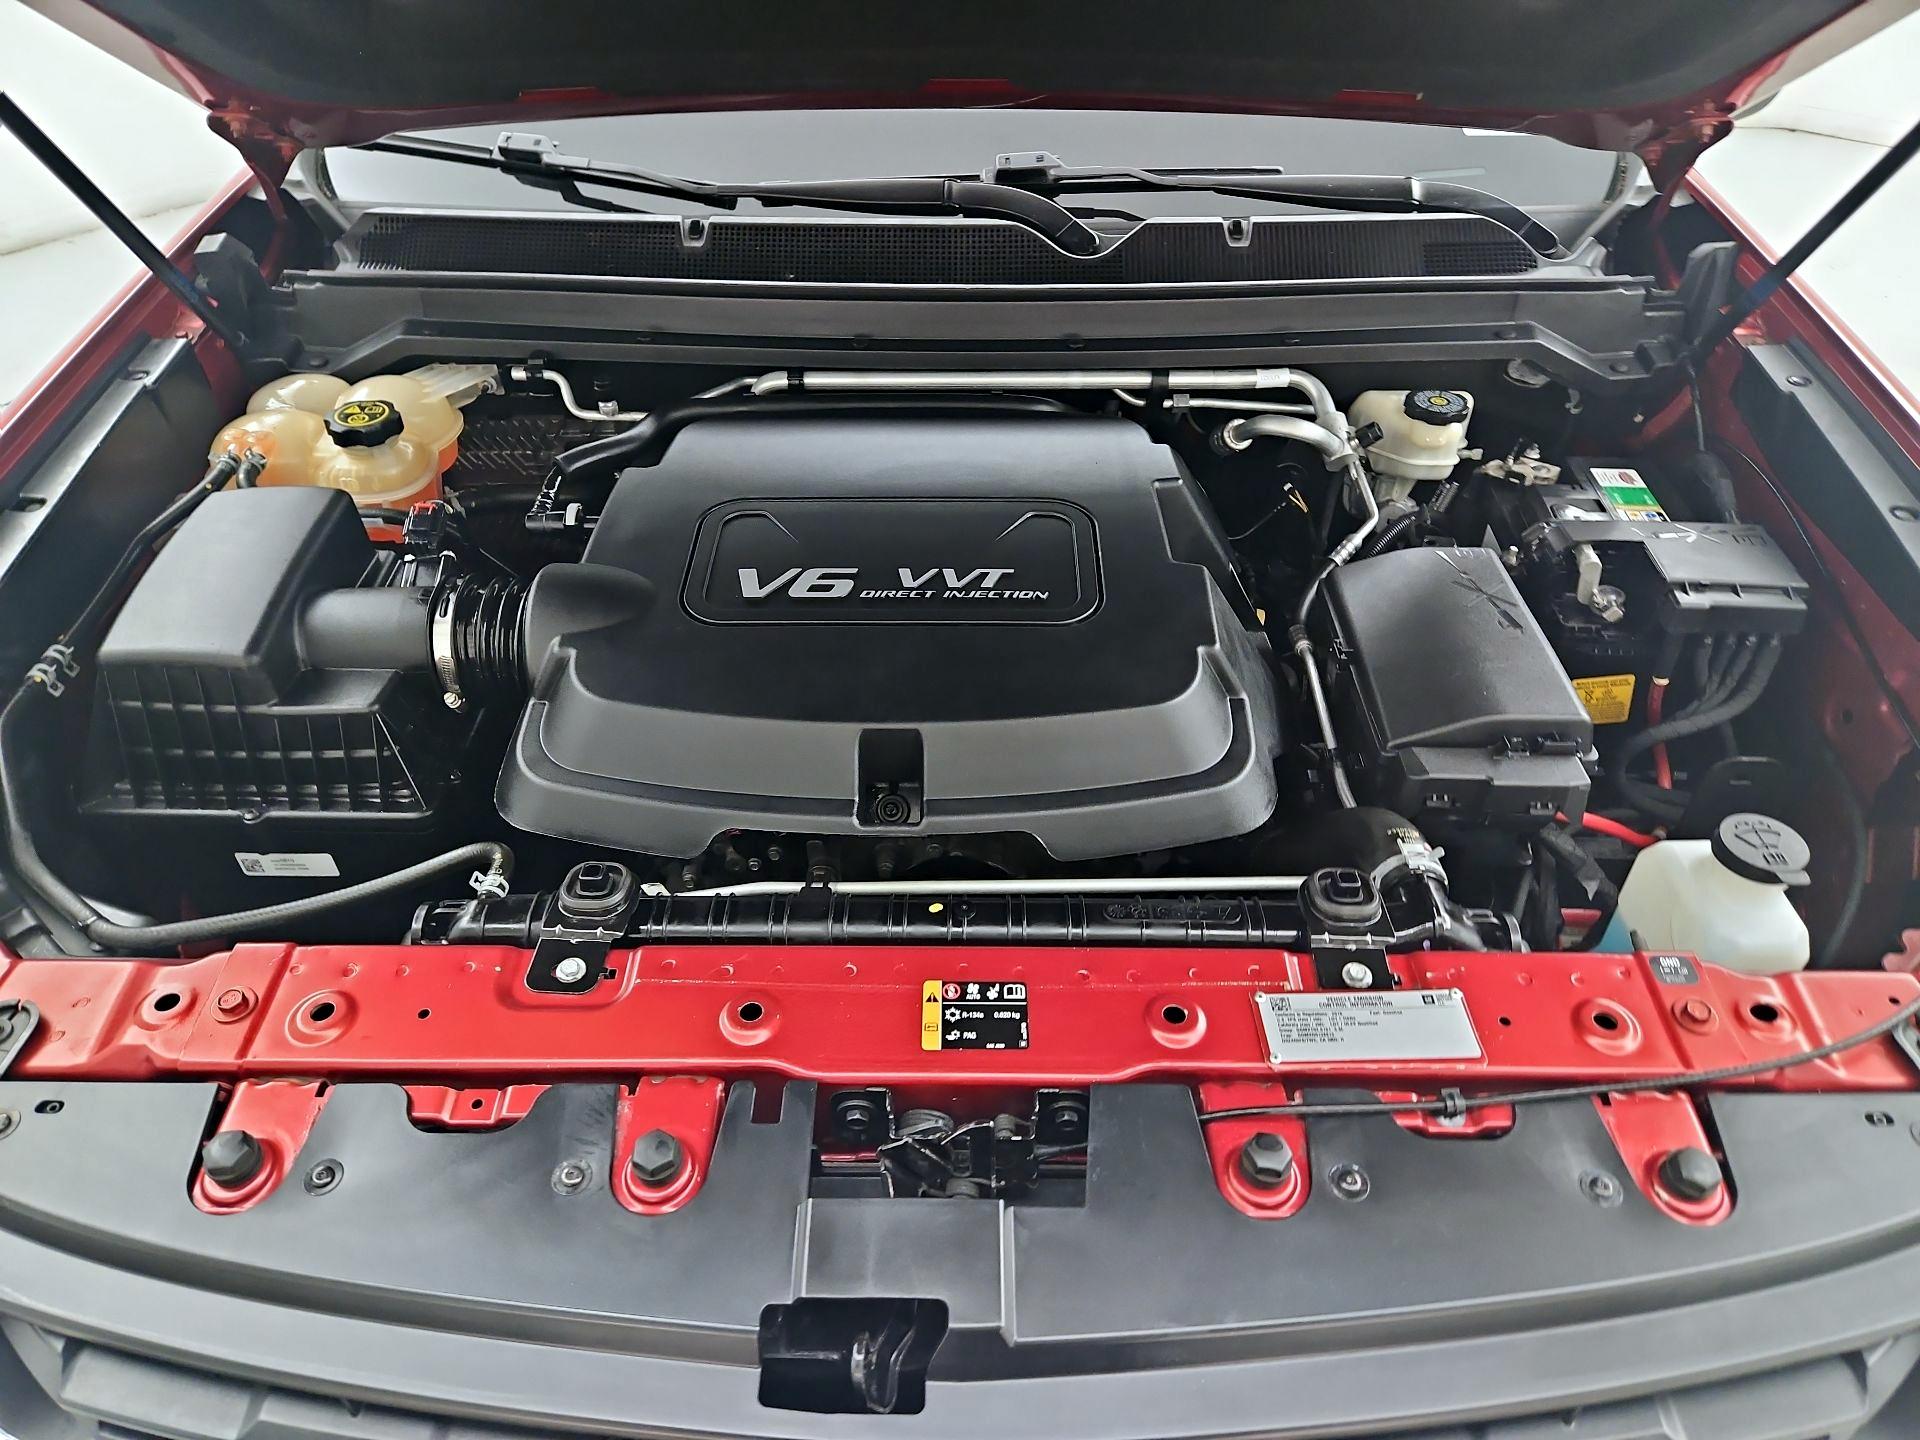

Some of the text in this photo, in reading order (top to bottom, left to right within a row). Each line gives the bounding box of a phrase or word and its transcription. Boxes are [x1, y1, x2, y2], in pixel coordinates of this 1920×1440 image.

[738, 568, 1015, 598] V6 VVT
[859, 590, 1050, 600] DIRECT INJECTION
[1011, 1011, 1021, 1020] kg
[963, 1031, 978, 1040] PAG
